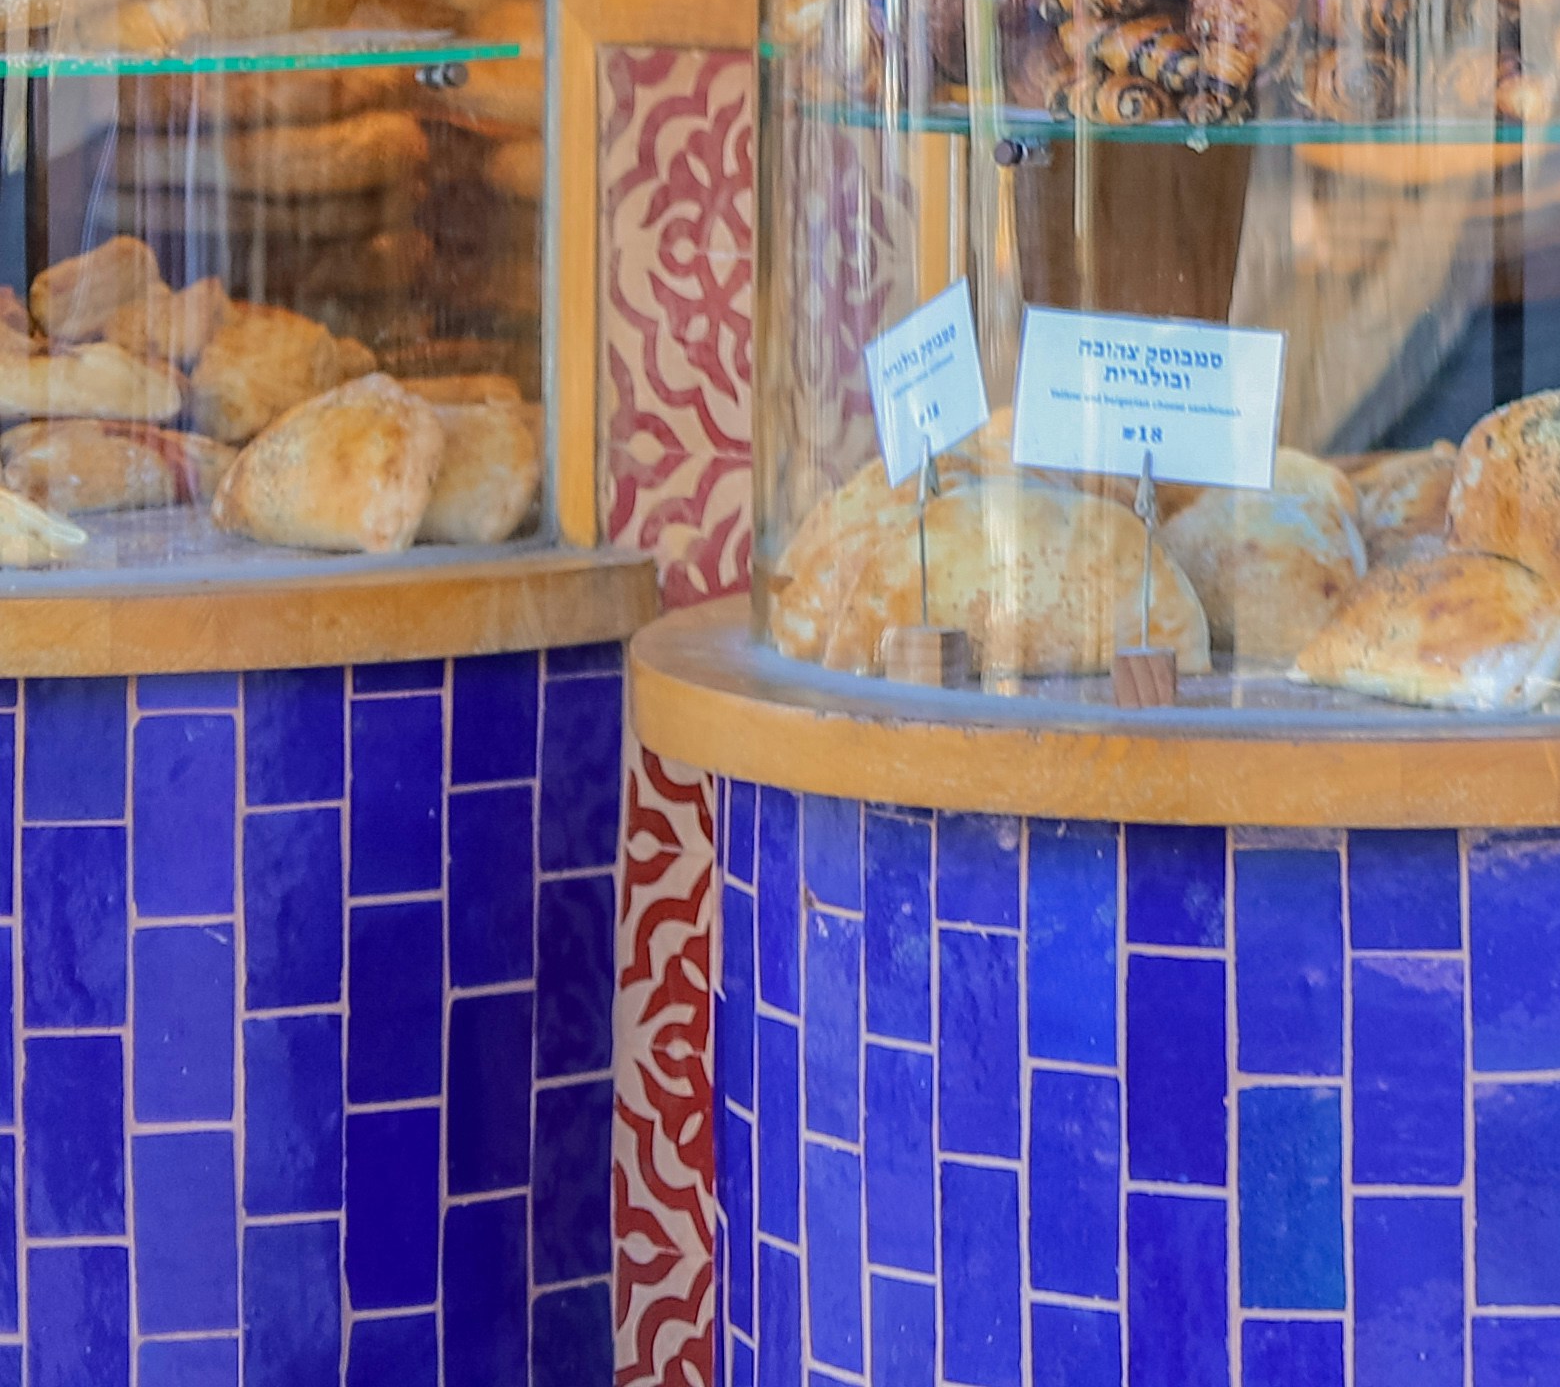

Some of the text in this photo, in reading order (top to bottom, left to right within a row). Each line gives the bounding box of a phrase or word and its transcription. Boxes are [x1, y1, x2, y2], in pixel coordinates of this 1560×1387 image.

[1078, 337, 1224, 370] סמבוסק צהובה
[1103, 364, 1191, 390] ובולגרית
